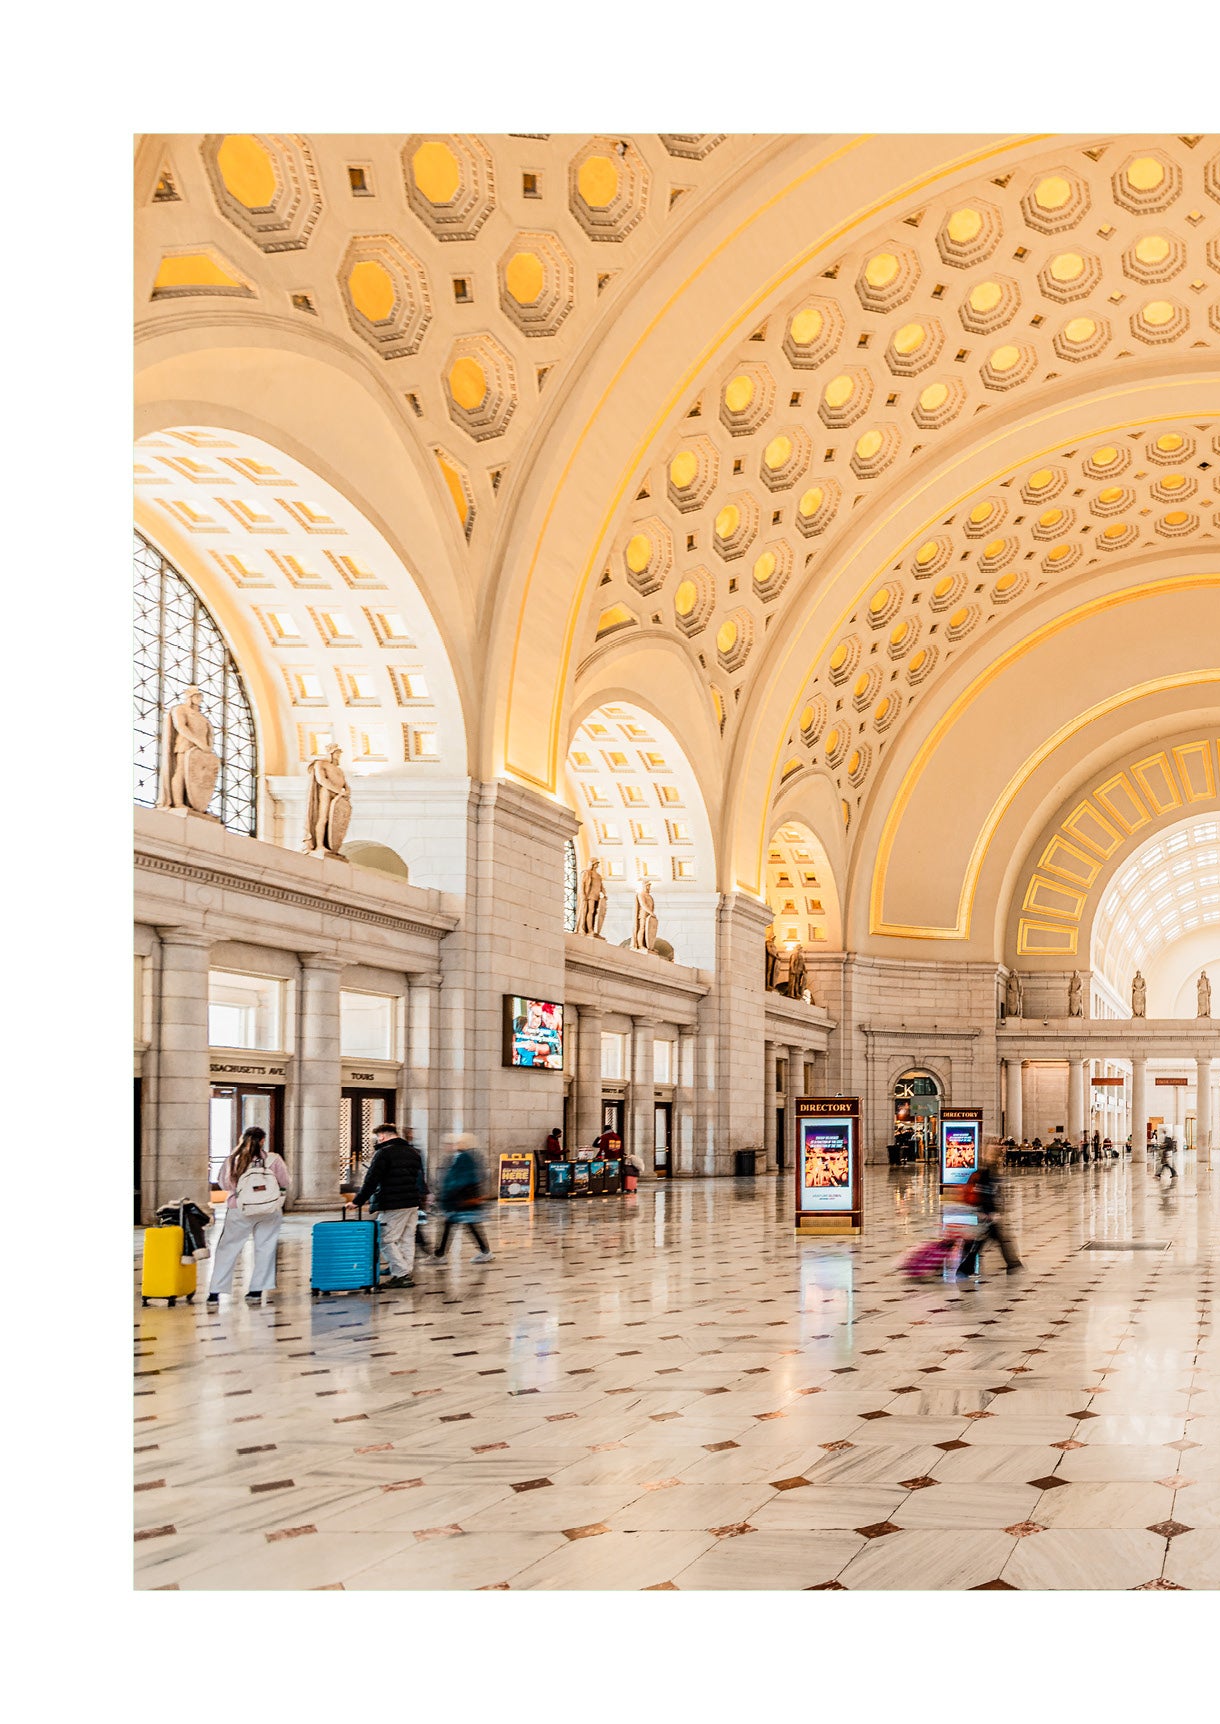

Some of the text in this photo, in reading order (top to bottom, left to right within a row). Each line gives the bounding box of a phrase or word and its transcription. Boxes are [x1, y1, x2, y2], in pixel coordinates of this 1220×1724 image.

[351, 1072, 375, 1081] TOURS
[800, 1103, 853, 1112] DIRECTORY
[502, 1172, 529, 1180] HERE
